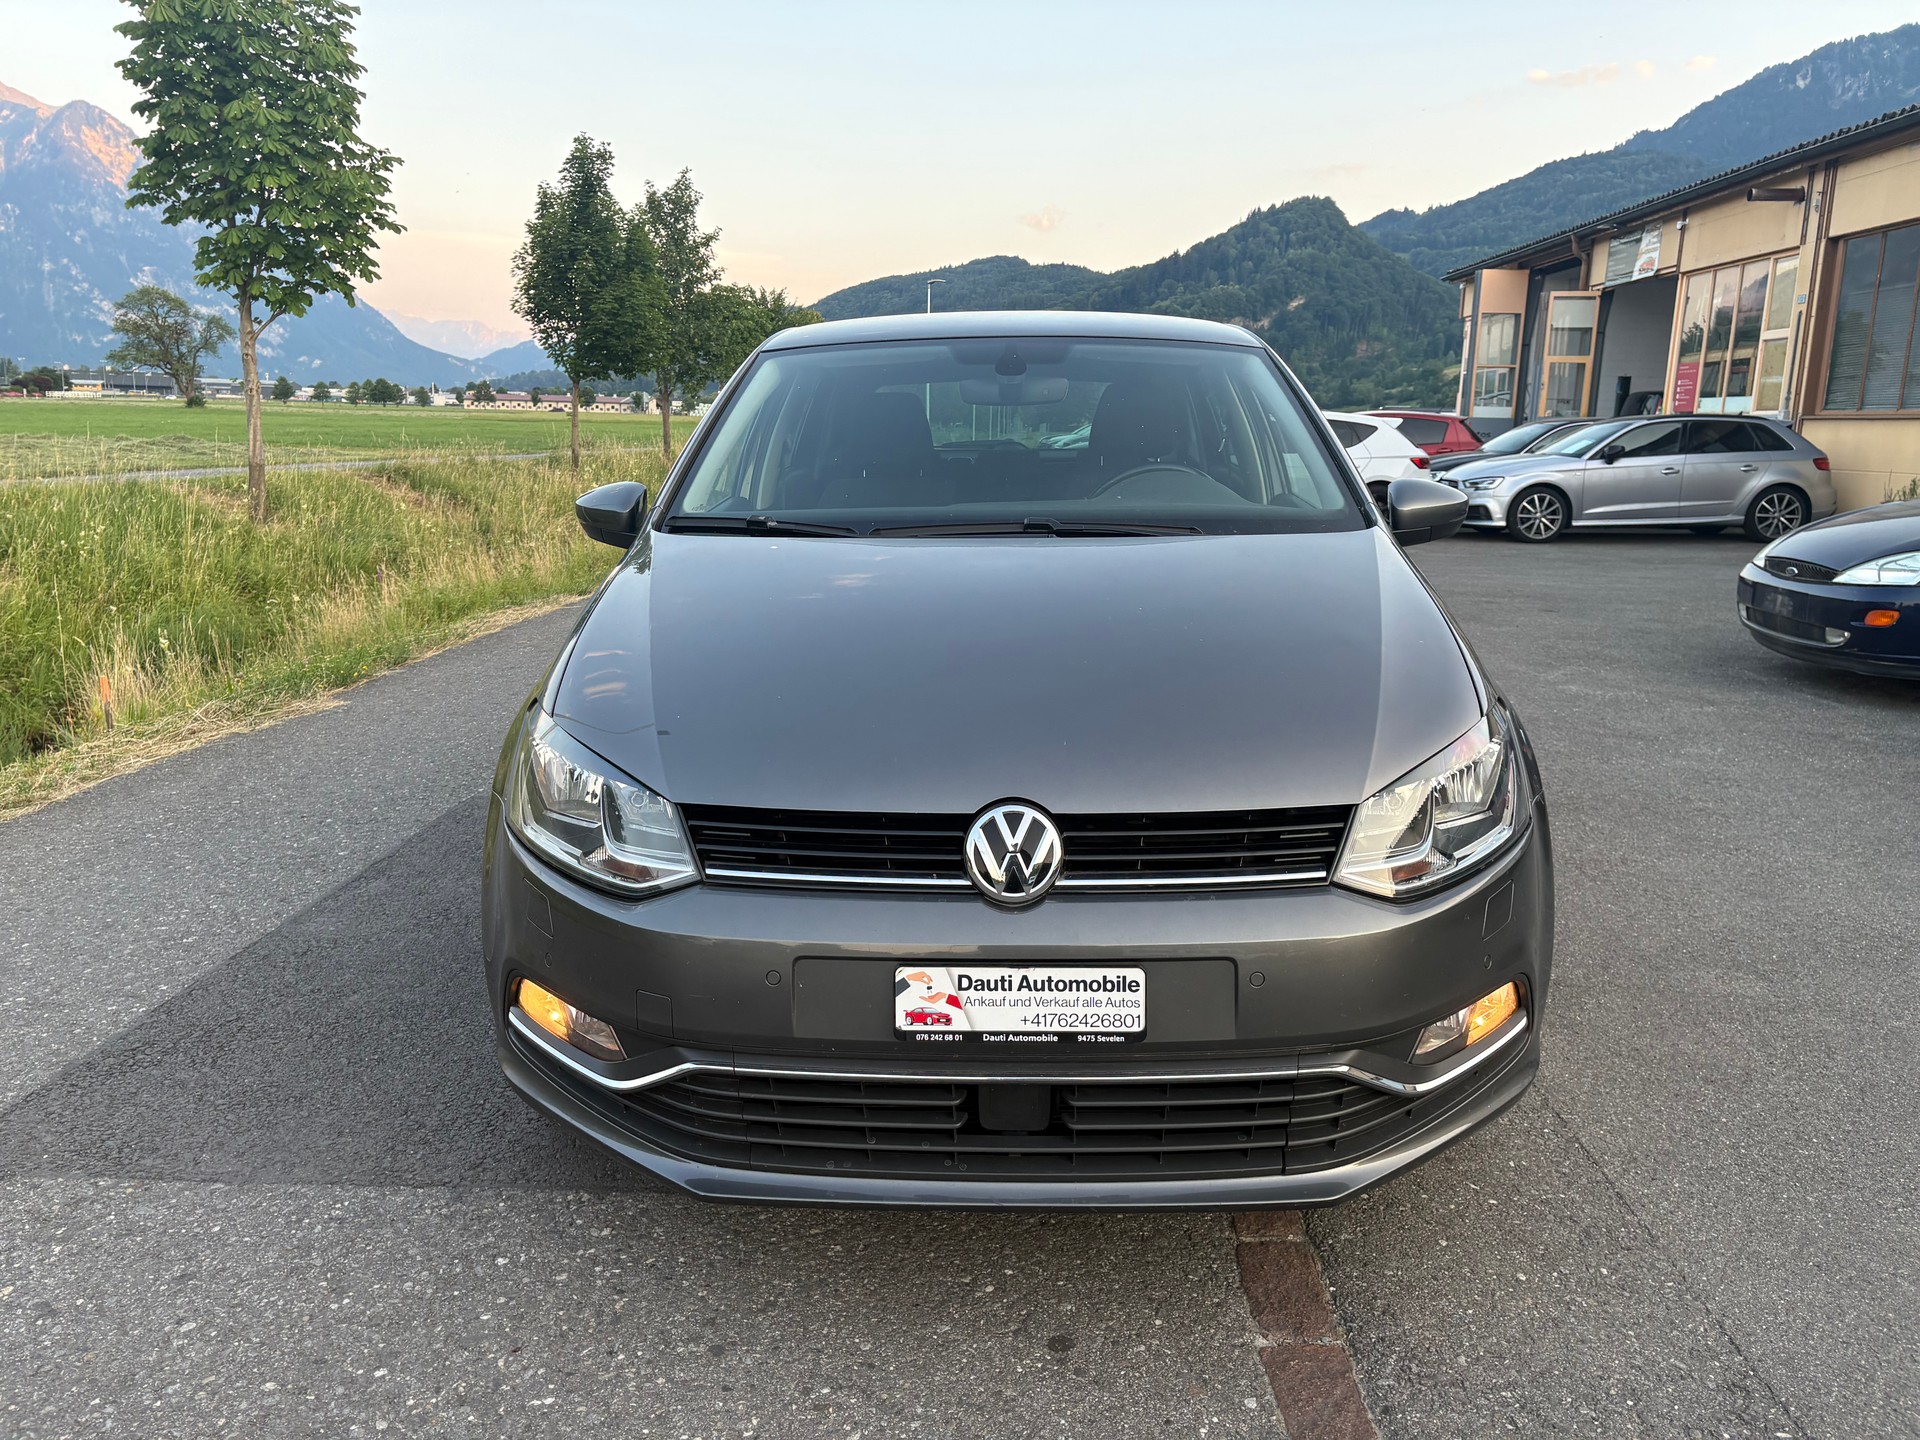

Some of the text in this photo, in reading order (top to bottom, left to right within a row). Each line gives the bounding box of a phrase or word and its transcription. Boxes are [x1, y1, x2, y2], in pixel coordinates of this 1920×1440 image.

[957, 975, 1141, 993] Dauti Automobile
[964, 996, 1141, 1009] Ankauf und Verkauf alle Autos
[1020, 1013, 1142, 1029] +41762426801
[983, 1034, 1058, 1042] Dauti Automobile
